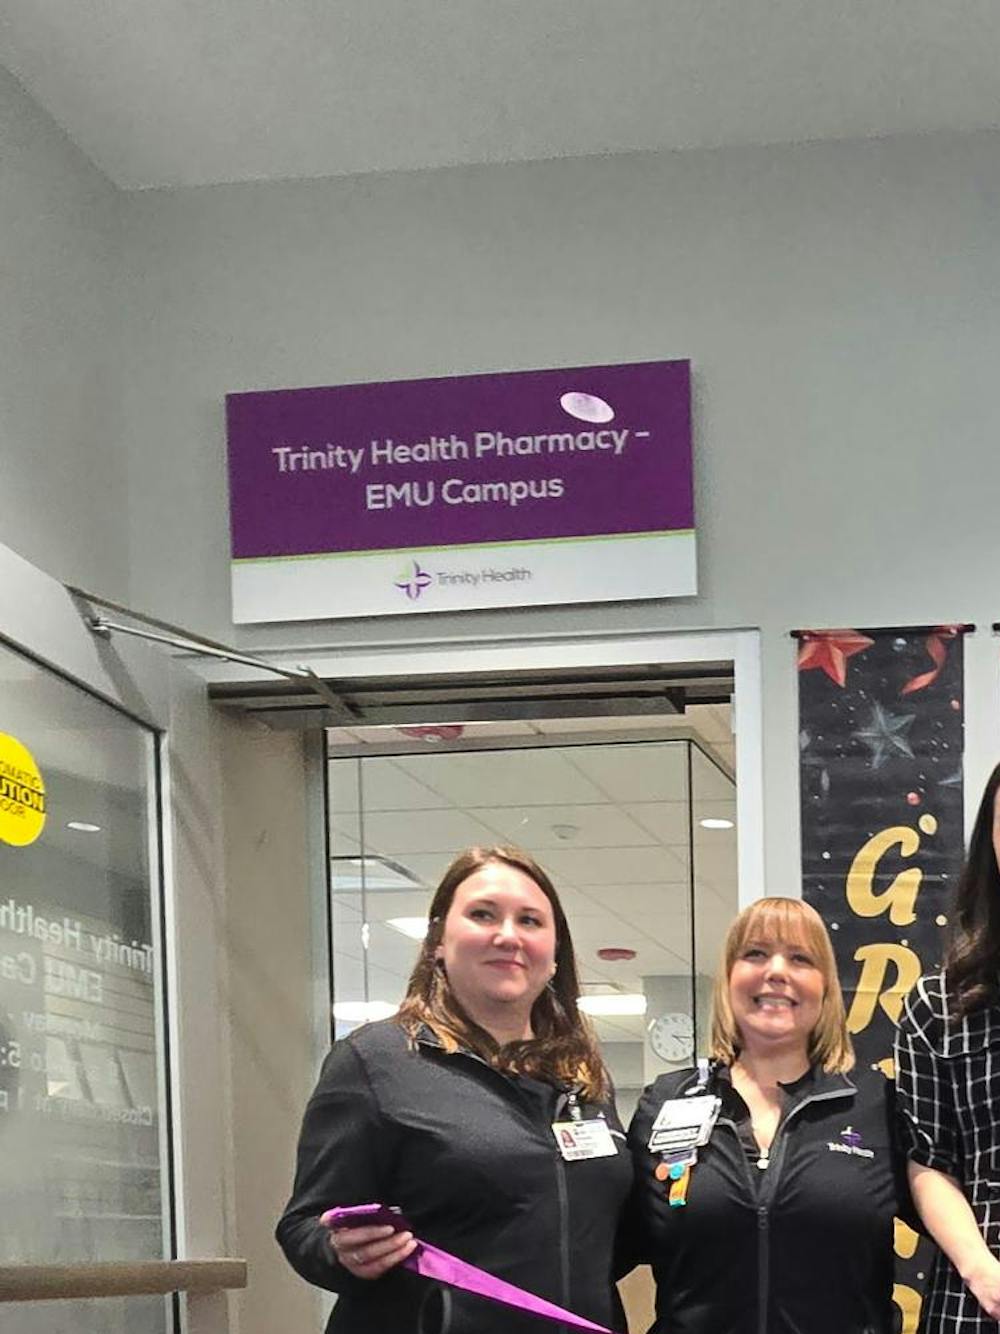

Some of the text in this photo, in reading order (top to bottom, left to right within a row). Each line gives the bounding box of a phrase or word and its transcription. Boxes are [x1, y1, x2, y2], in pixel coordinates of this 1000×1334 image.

[272, 443, 365, 474] Trinity
[371, 435, 469, 465] Health
[475, 429, 629, 457] Pharmacy
[366, 478, 564, 510] EMU Campus
[437, 567, 532, 586] Trinity Health
